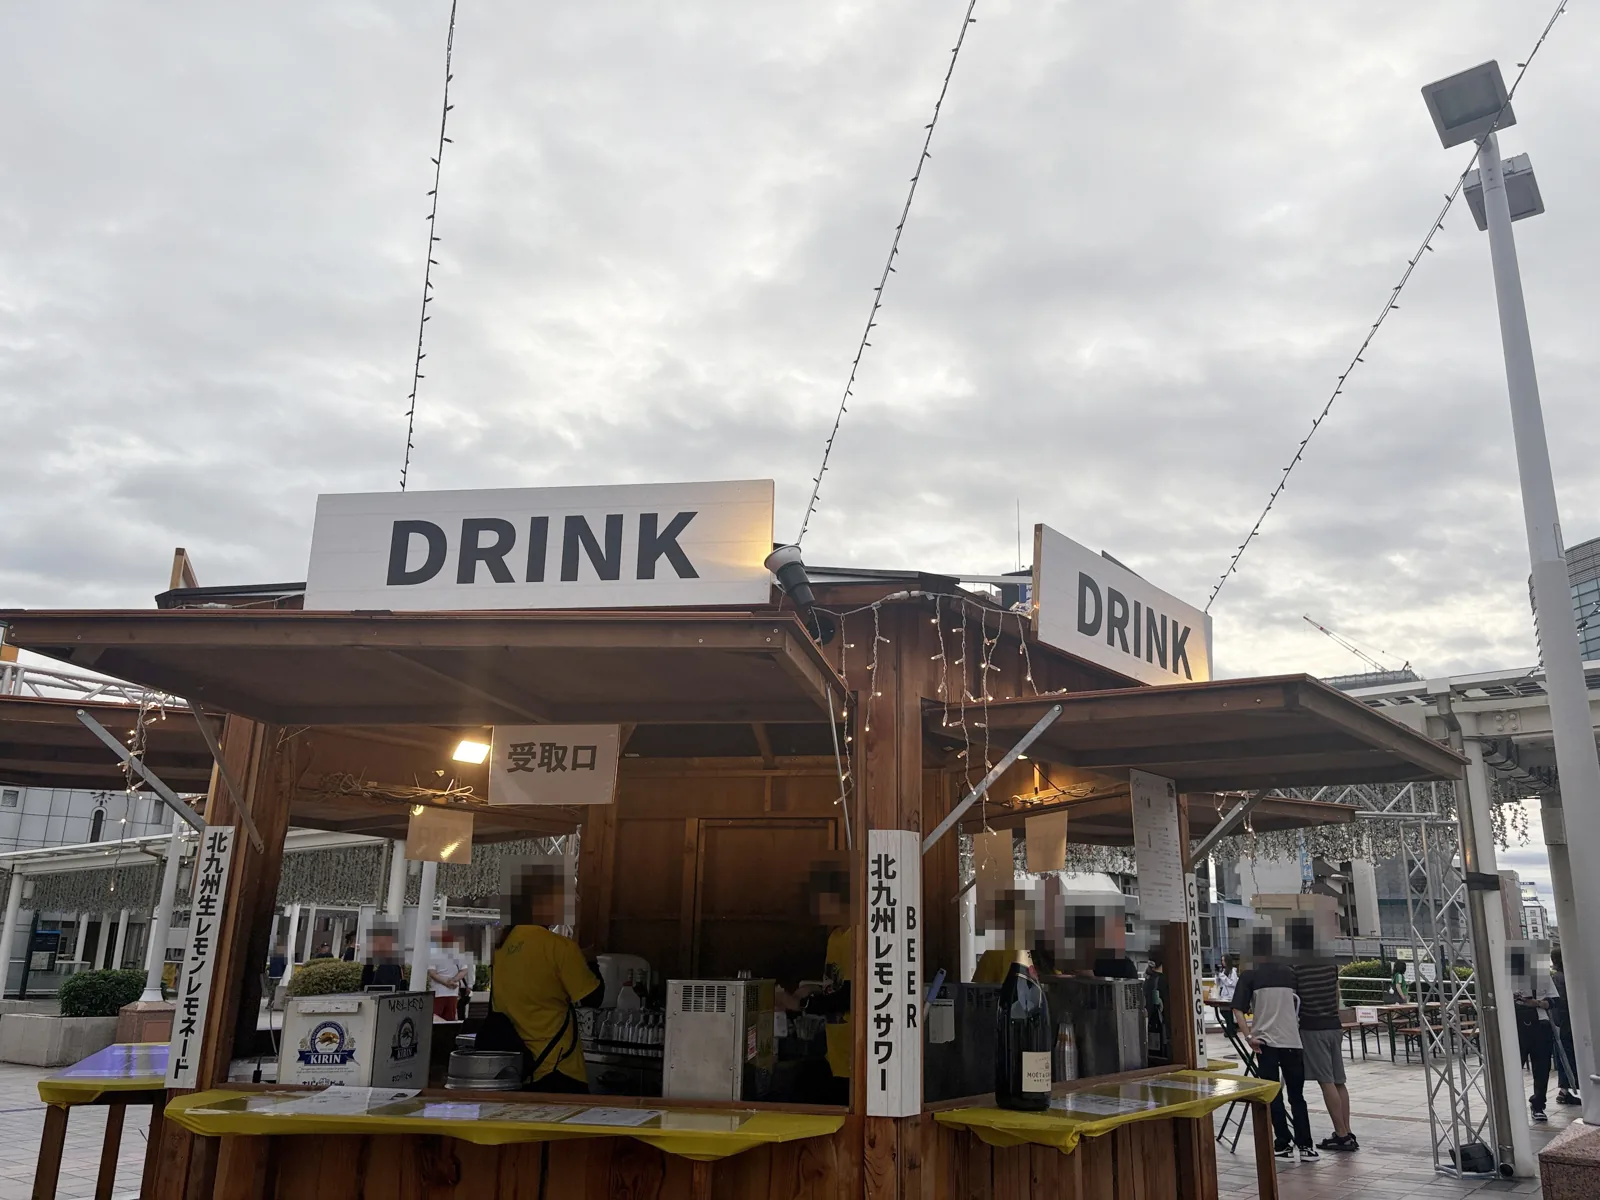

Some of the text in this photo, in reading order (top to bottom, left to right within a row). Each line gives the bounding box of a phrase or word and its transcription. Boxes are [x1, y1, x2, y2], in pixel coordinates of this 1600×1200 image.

[387, 512, 699, 585] DRINK
[1077, 571, 1193, 681] DRINK
[506, 741, 598, 773] 受取口
[173, 832, 228, 1079] 北九州生レモンレモネード
[870, 853, 898, 1091] 北九州レモンサワー
[906, 906, 917, 1028] BEER
[1188, 882, 1204, 1056] CHAMPAGNE
[310, 1054, 341, 1064] KIRIN
